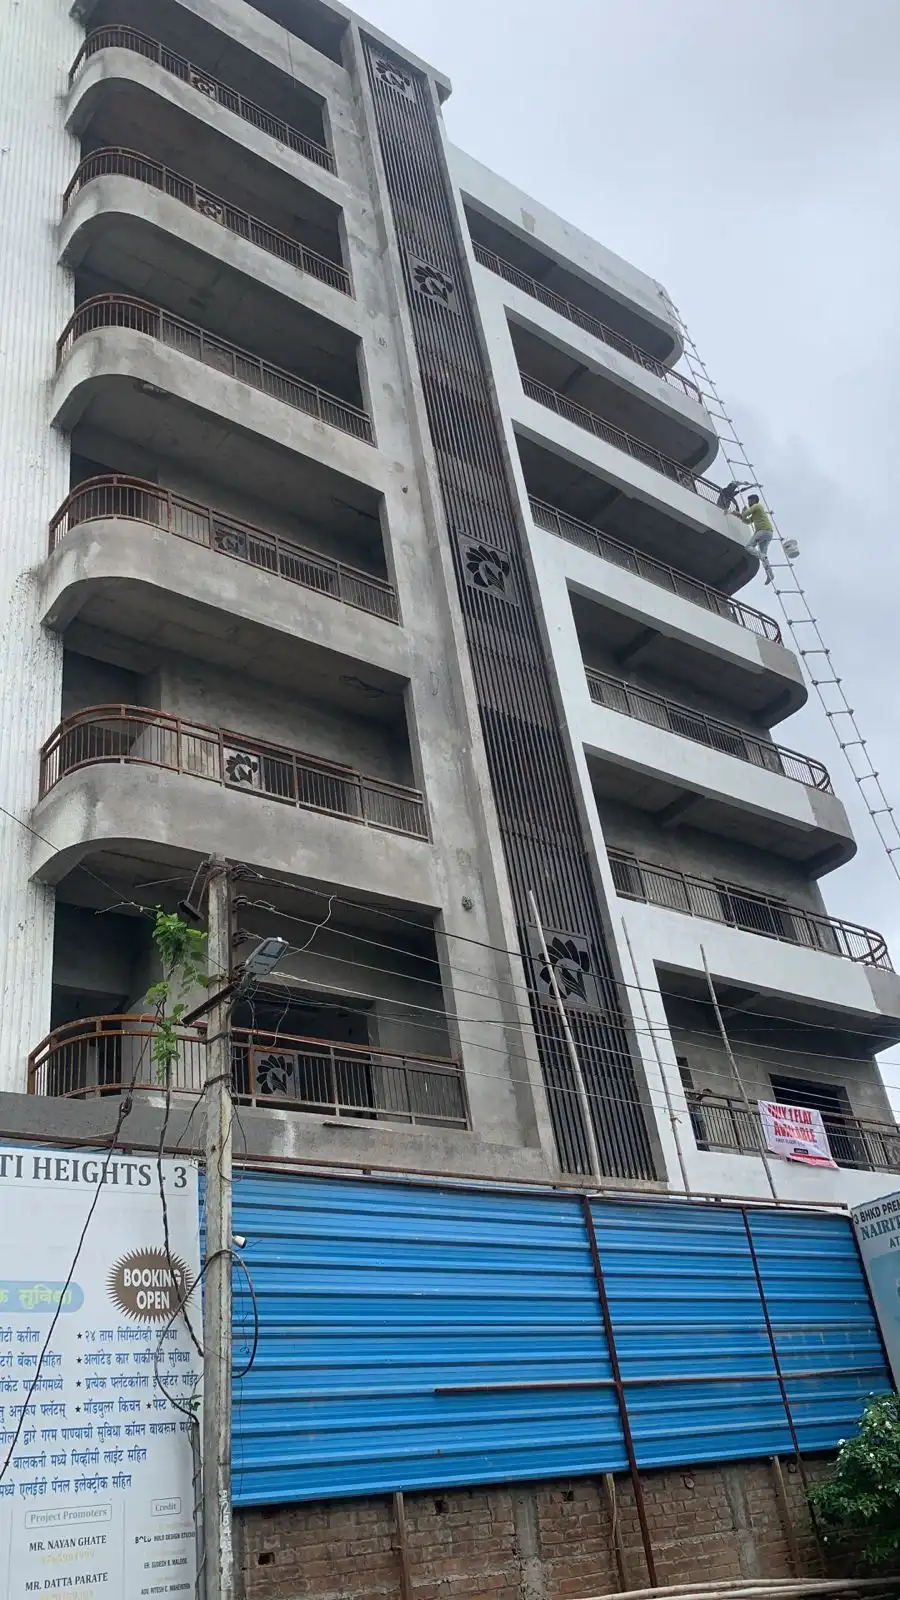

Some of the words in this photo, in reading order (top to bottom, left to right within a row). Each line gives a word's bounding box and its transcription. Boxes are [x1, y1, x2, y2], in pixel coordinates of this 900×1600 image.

[32, 1156, 152, 1186] HEIGHTS
[174, 1166, 188, 1188] 3
[123, 1268, 182, 1288] BOOKING
[136, 1290, 170, 1310] OPEN
[127, 1444, 147, 1463] सहित
[112, 1471, 132, 1490] सहित
[30, 1513, 61, 1523] Project
[63, 1508, 108, 1520] Promoters
[155, 1502, 177, 1512] Credit
[28, 1541, 46, 1552] MR.
[47, 1537, 76, 1550] NAYAN
[77, 1534, 107, 1547] GHATE
[25, 1581, 42, 1592] MR.
[44, 1576, 73, 1589] DATTA
[74, 1572, 109, 1585] PARATE
